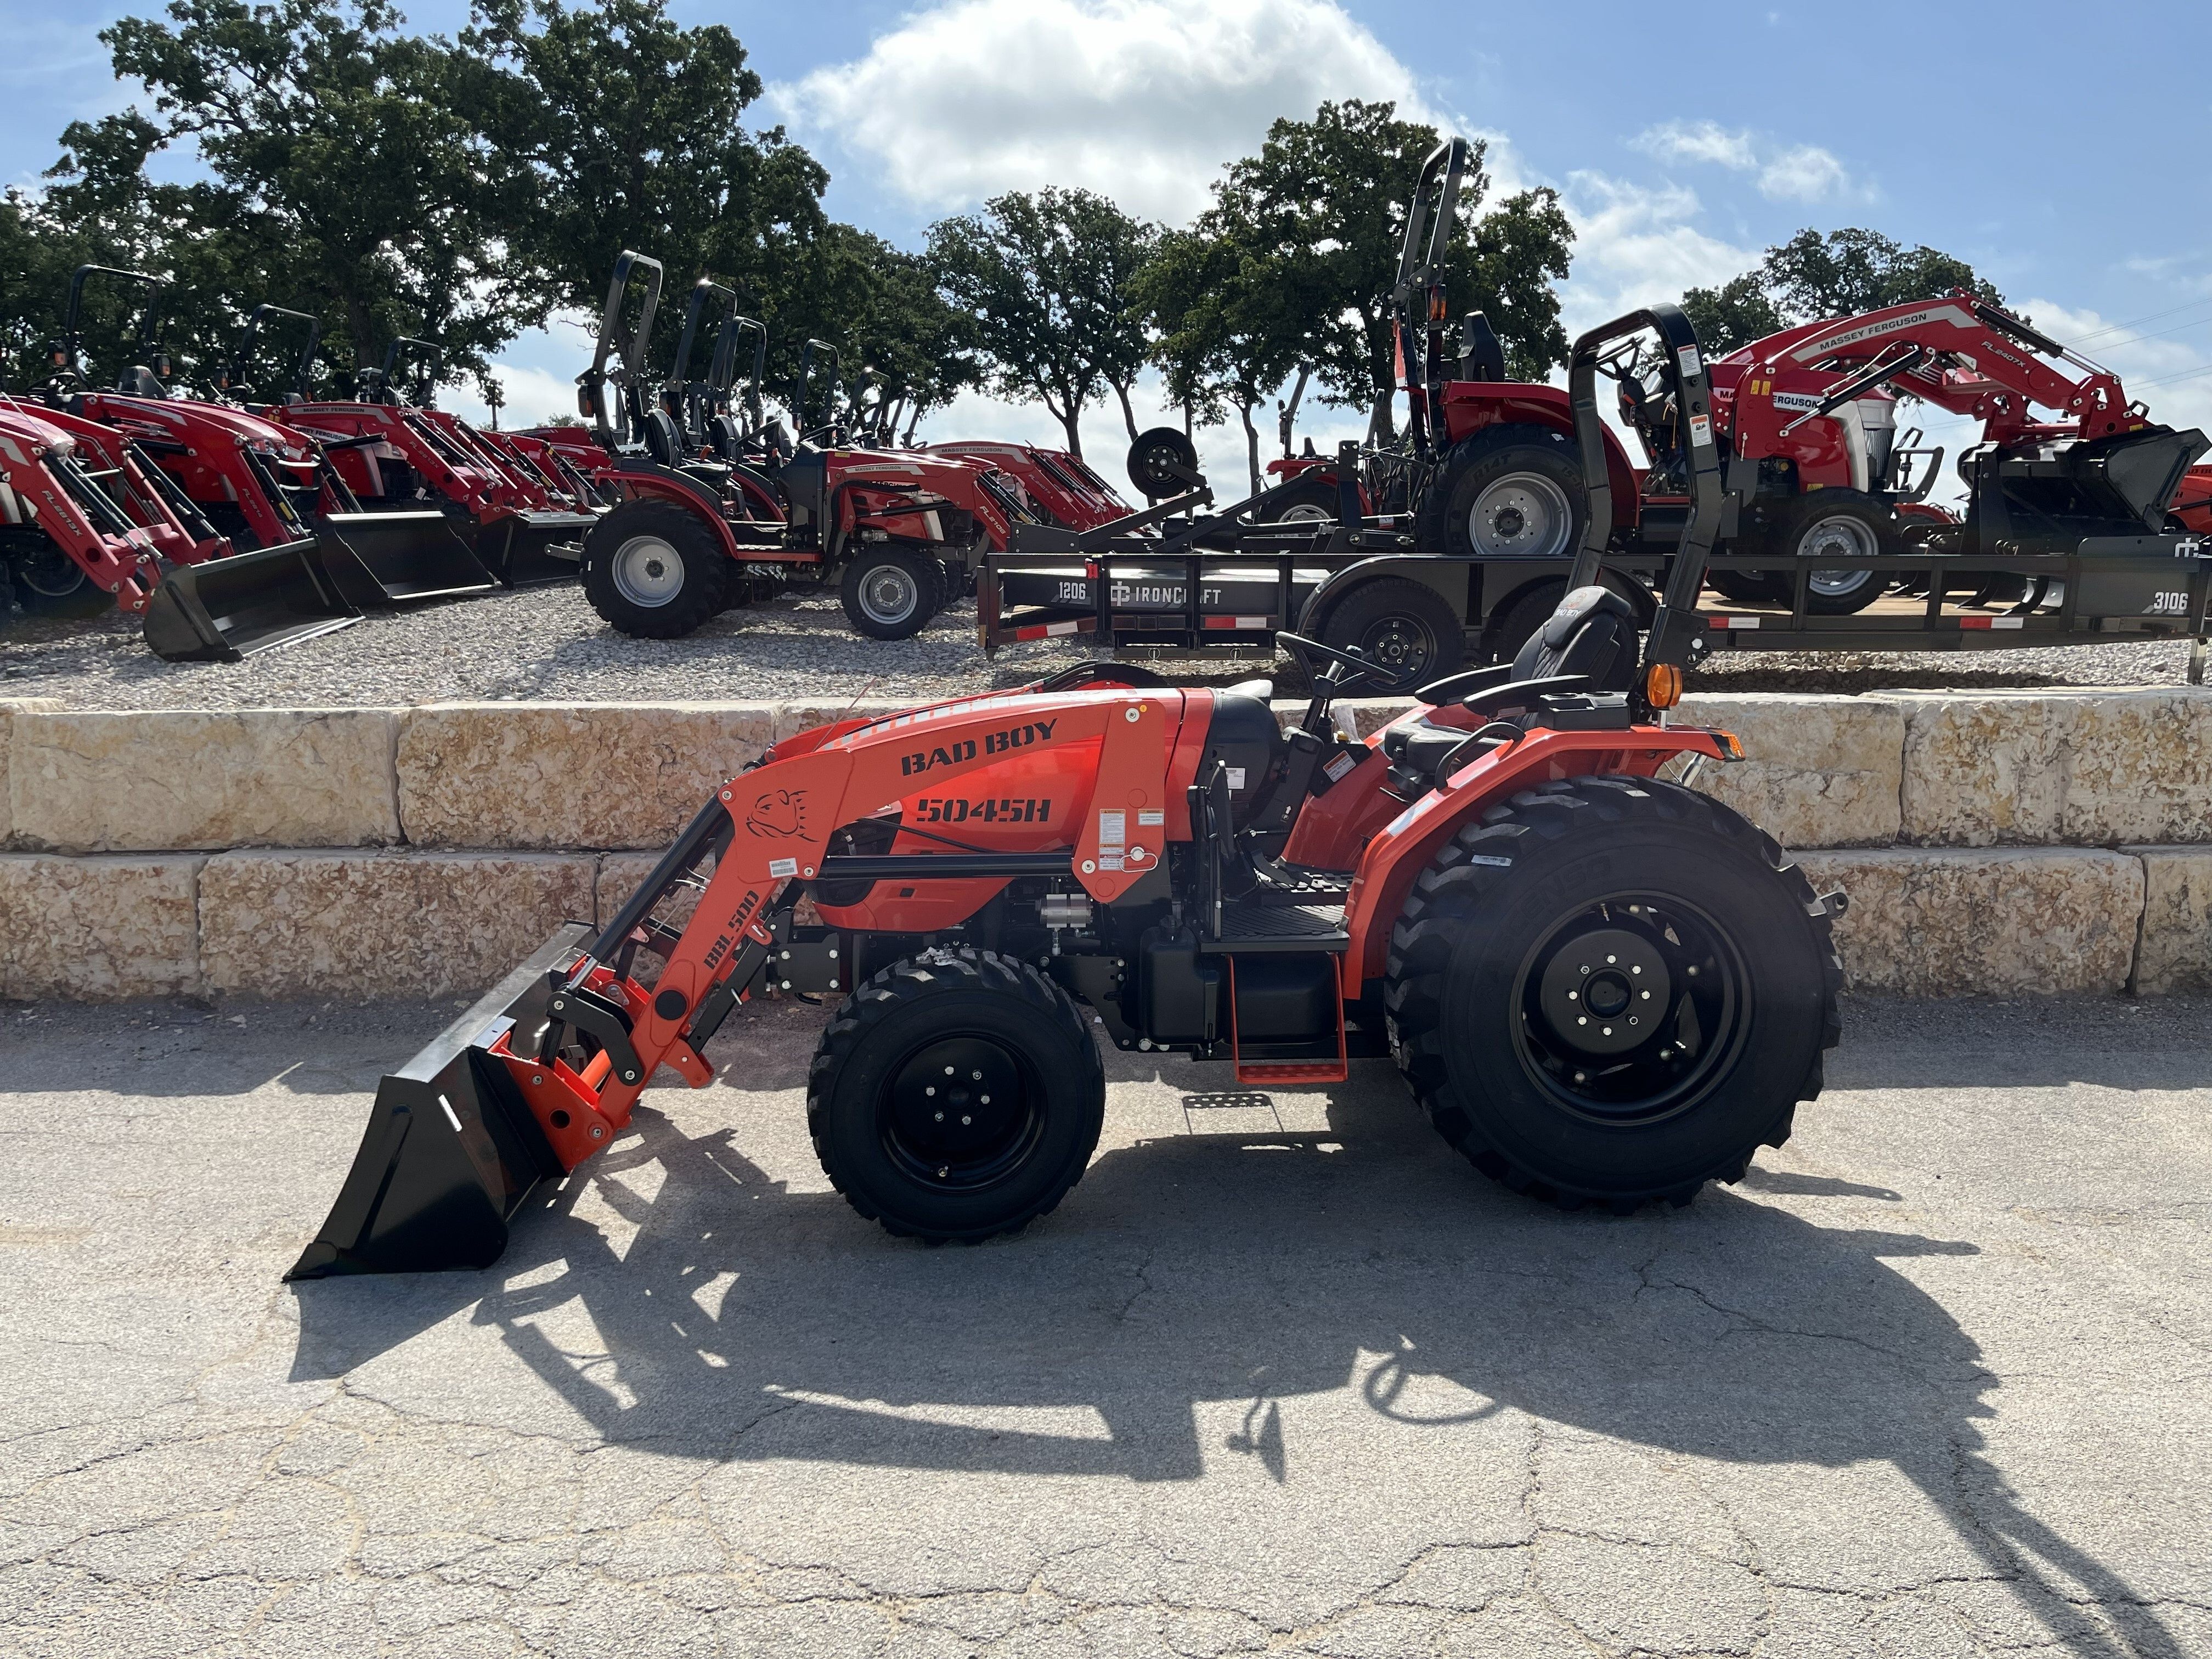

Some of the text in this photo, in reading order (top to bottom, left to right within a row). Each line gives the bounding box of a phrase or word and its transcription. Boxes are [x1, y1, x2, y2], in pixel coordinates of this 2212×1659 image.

[1820, 313, 1927, 351] MASSEY FERGUSON
[1773, 395, 1820, 408] ERGUSON
[1059, 582, 1086, 600] 1206
[1136, 587, 1221, 604] IRONCFT
[2154, 591, 2189, 610] 3106
[1566, 609, 1582, 617] BOY
[901, 718, 1058, 776] BAD BOY
[917, 799, 1051, 822] 5045H
[728, 890, 759, 933] 500
